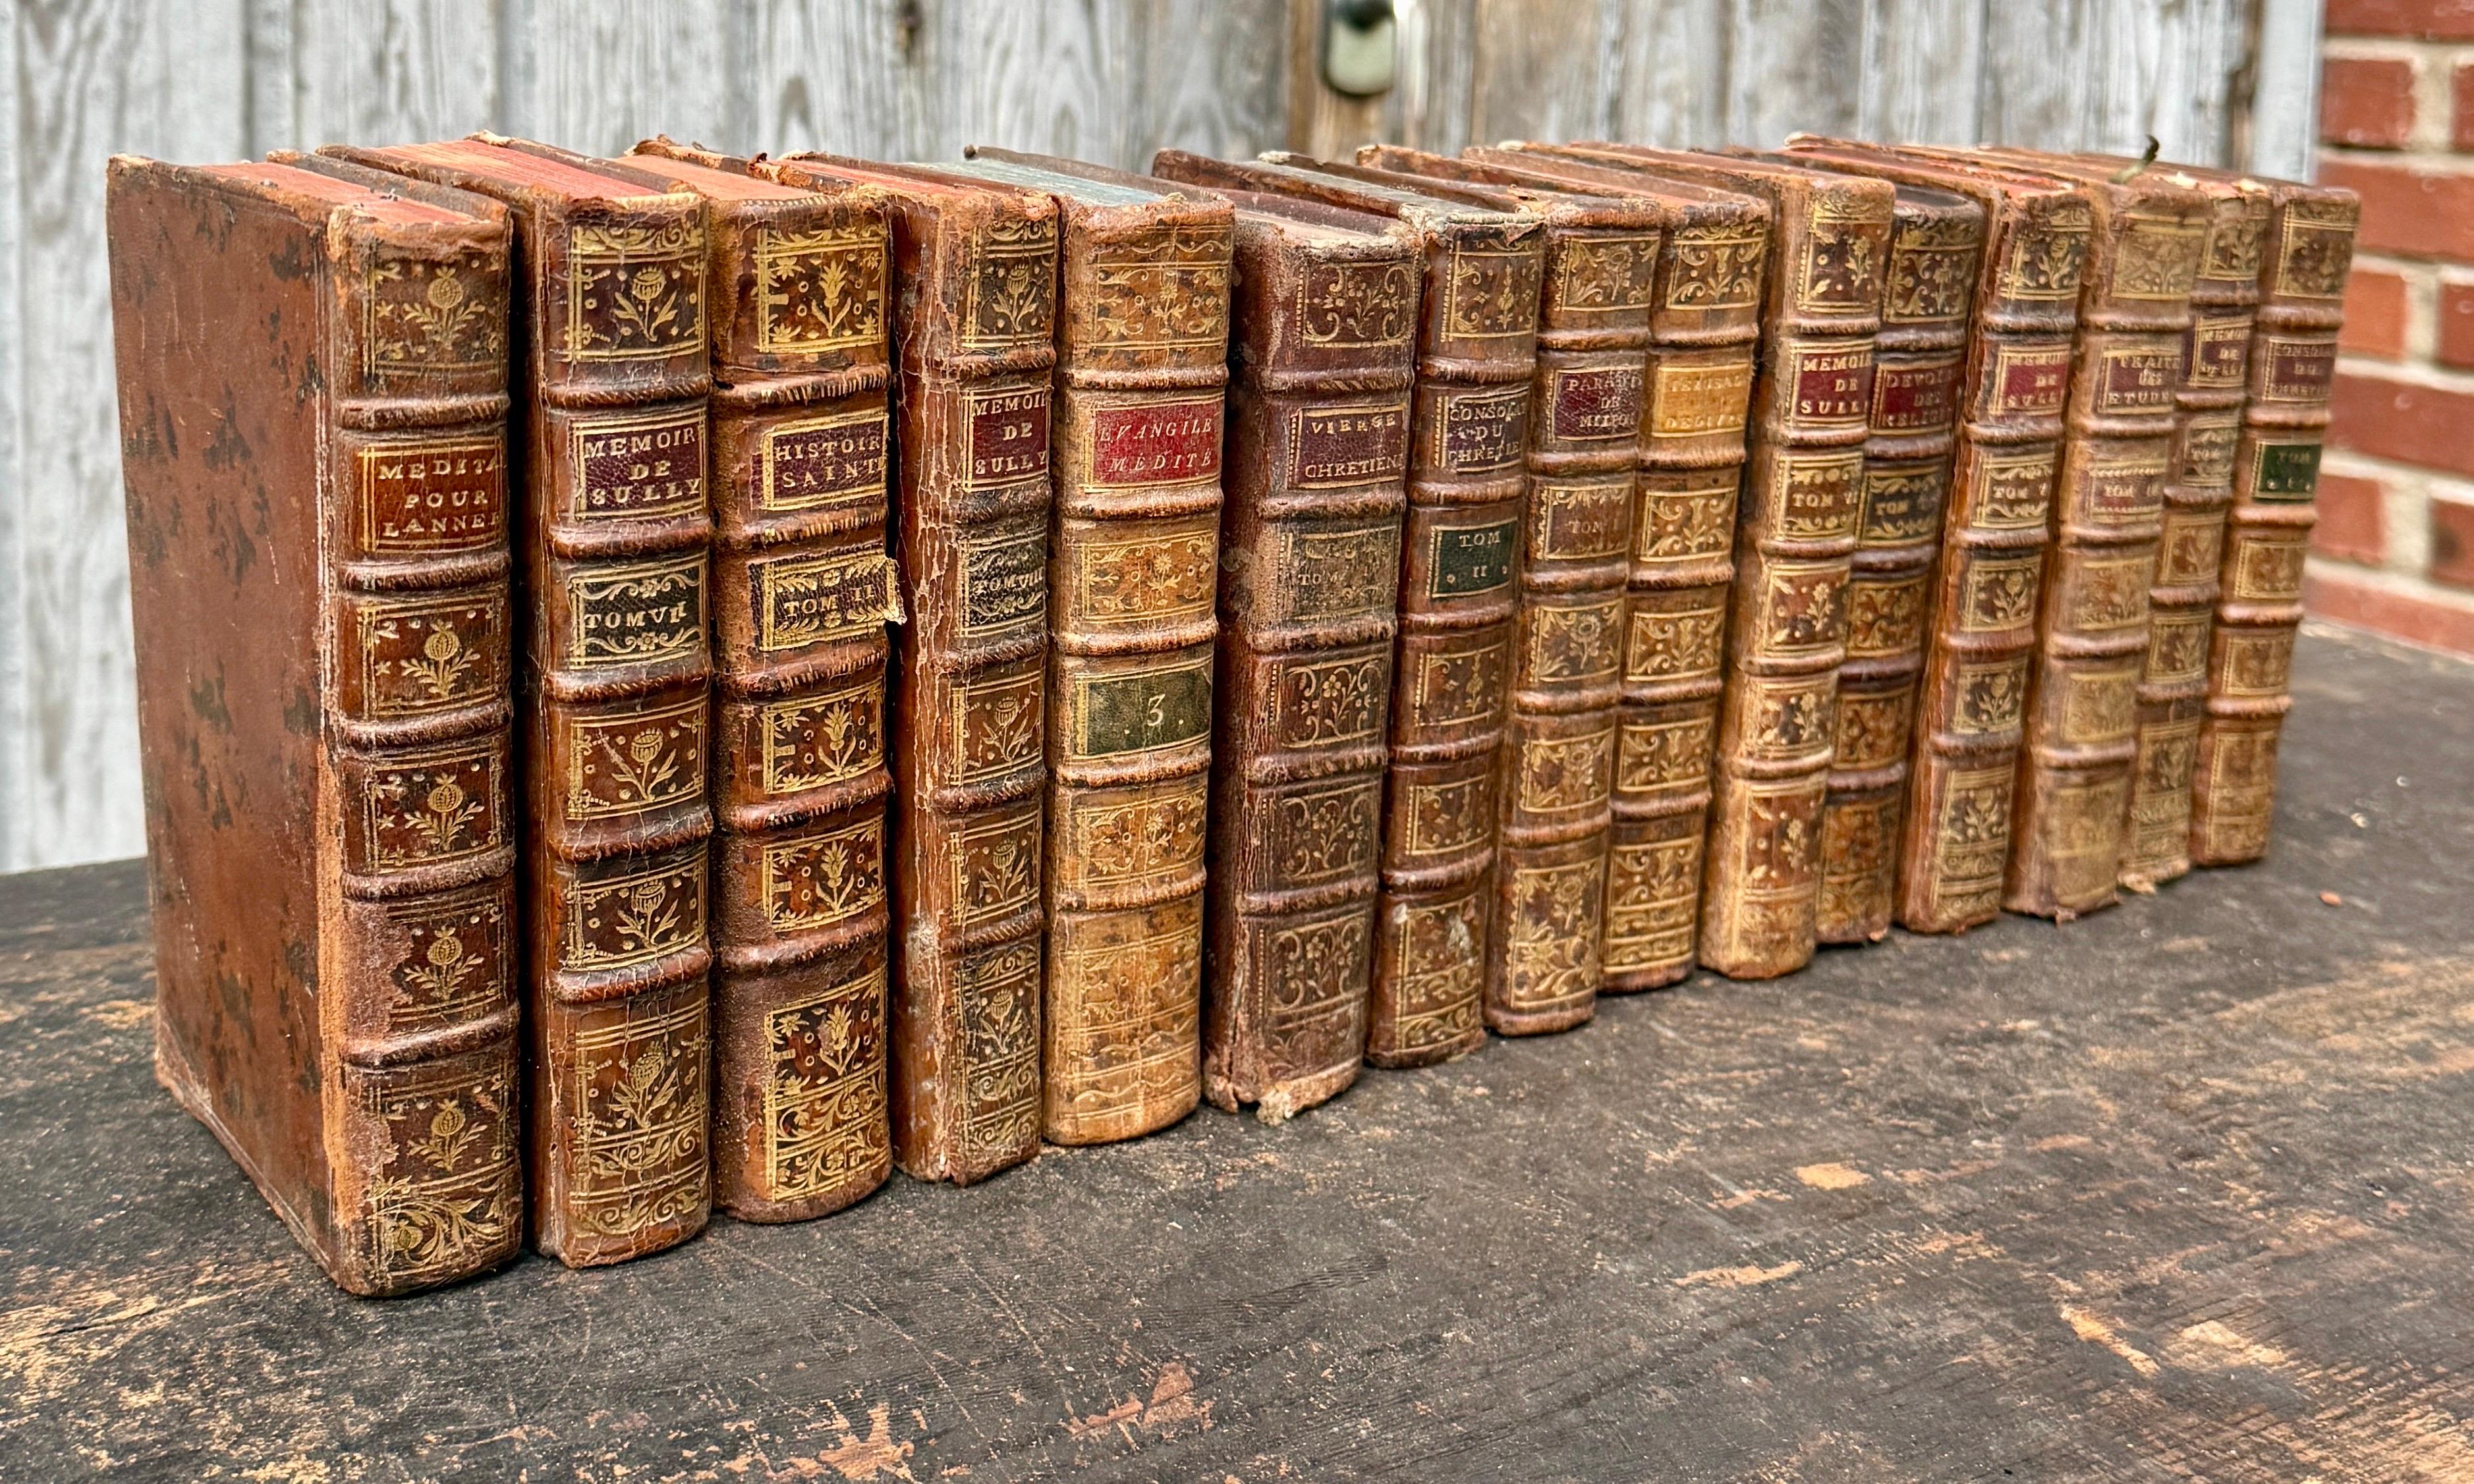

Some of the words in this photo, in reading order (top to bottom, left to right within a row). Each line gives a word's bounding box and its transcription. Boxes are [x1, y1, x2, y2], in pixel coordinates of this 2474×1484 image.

[1835, 379, 1857, 392] DE
[1003, 422, 1032, 441] DE
[1311, 414, 1395, 434] VIERGE
[1475, 424, 1502, 439] DU
[584, 427, 695, 458] MEMOIR
[774, 436, 880, 461] HISTOIR
[628, 460, 671, 480] DE
[405, 490, 488, 508] POUR
[593, 478, 702, 505] SULLY
[1793, 493, 1833, 507] TOM
[1459, 531, 1500, 547] TOM
[1473, 565, 1487, 578] II
[783, 594, 838, 617] TOM
